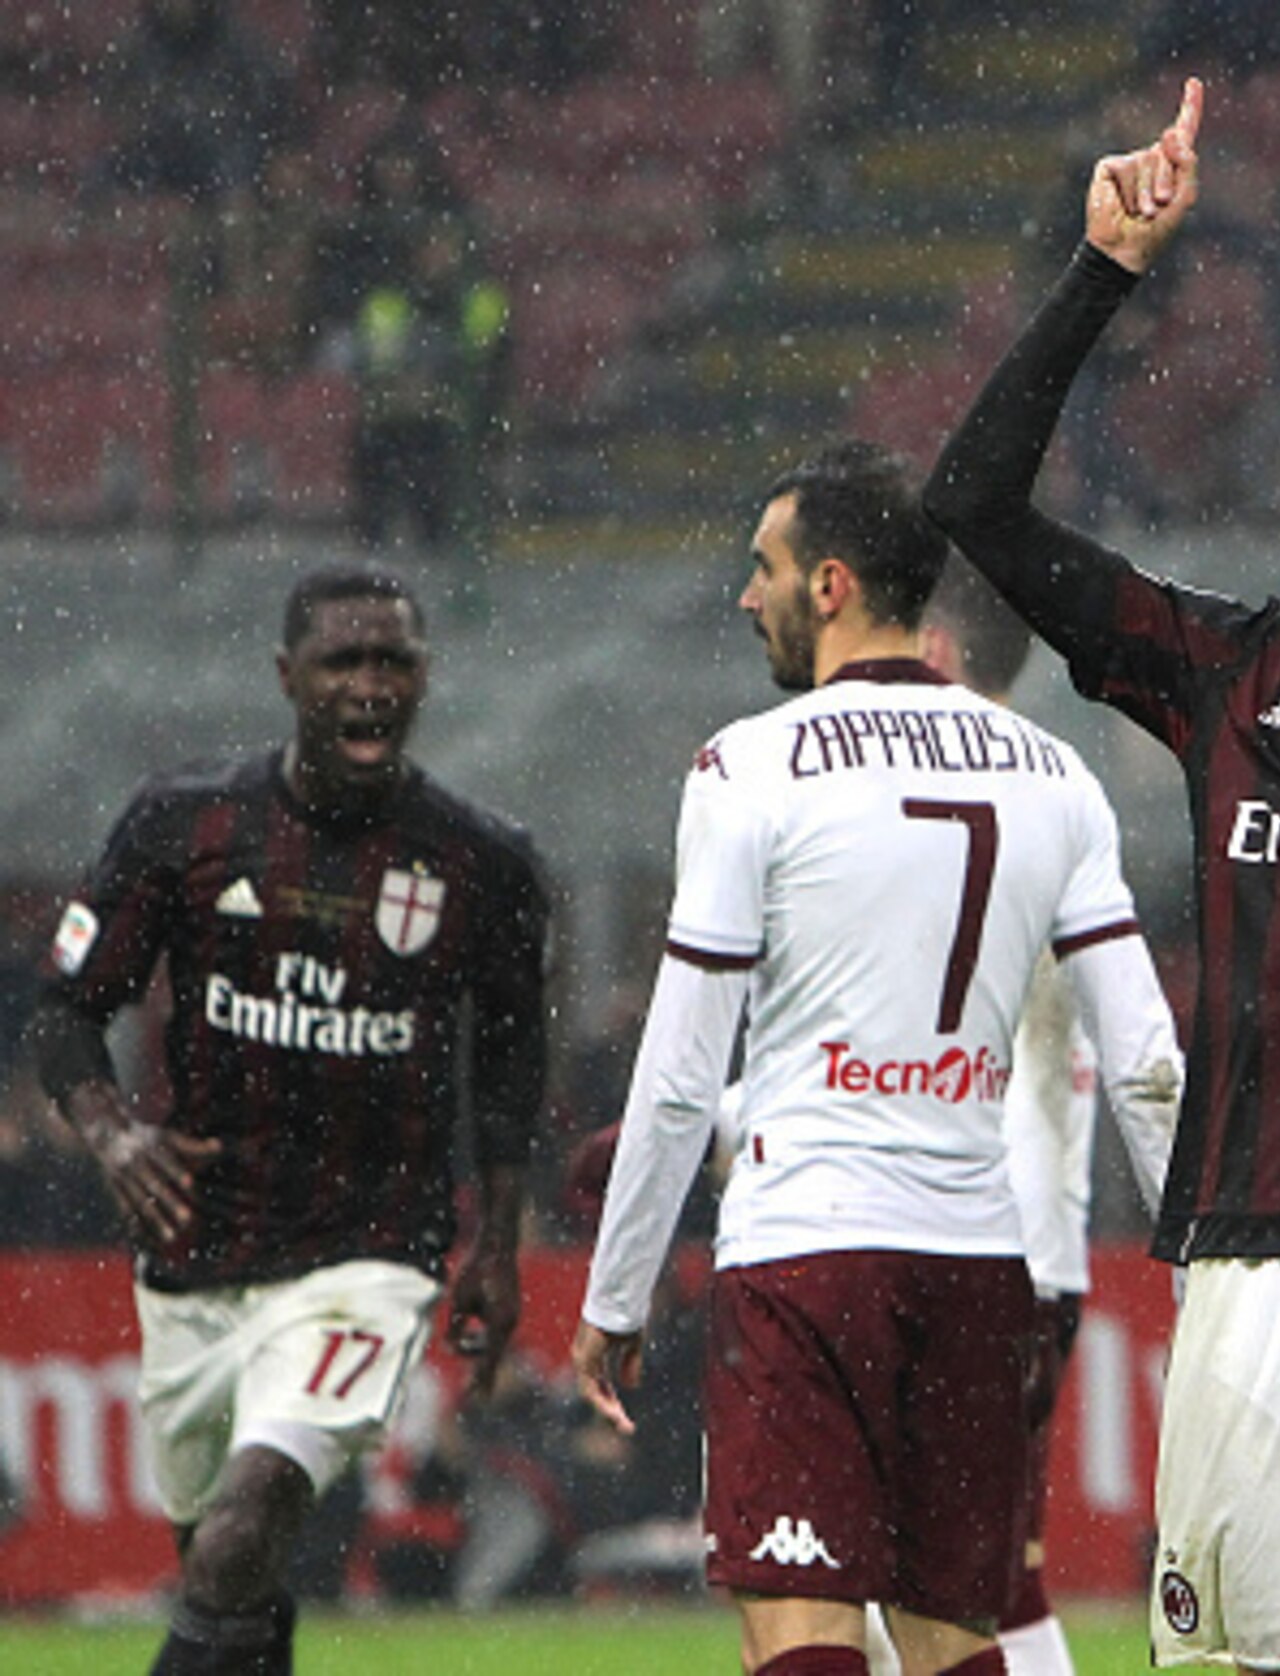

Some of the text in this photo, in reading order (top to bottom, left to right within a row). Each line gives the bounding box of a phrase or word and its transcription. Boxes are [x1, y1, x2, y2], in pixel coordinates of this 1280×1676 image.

[787, 710, 1066, 780] ZAPPACOSTA
[901, 797, 998, 1035] 7
[276, 953, 347, 1001] Fly
[206, 973, 414, 1056] Emirates
[302, 1328, 384, 1399] 17
